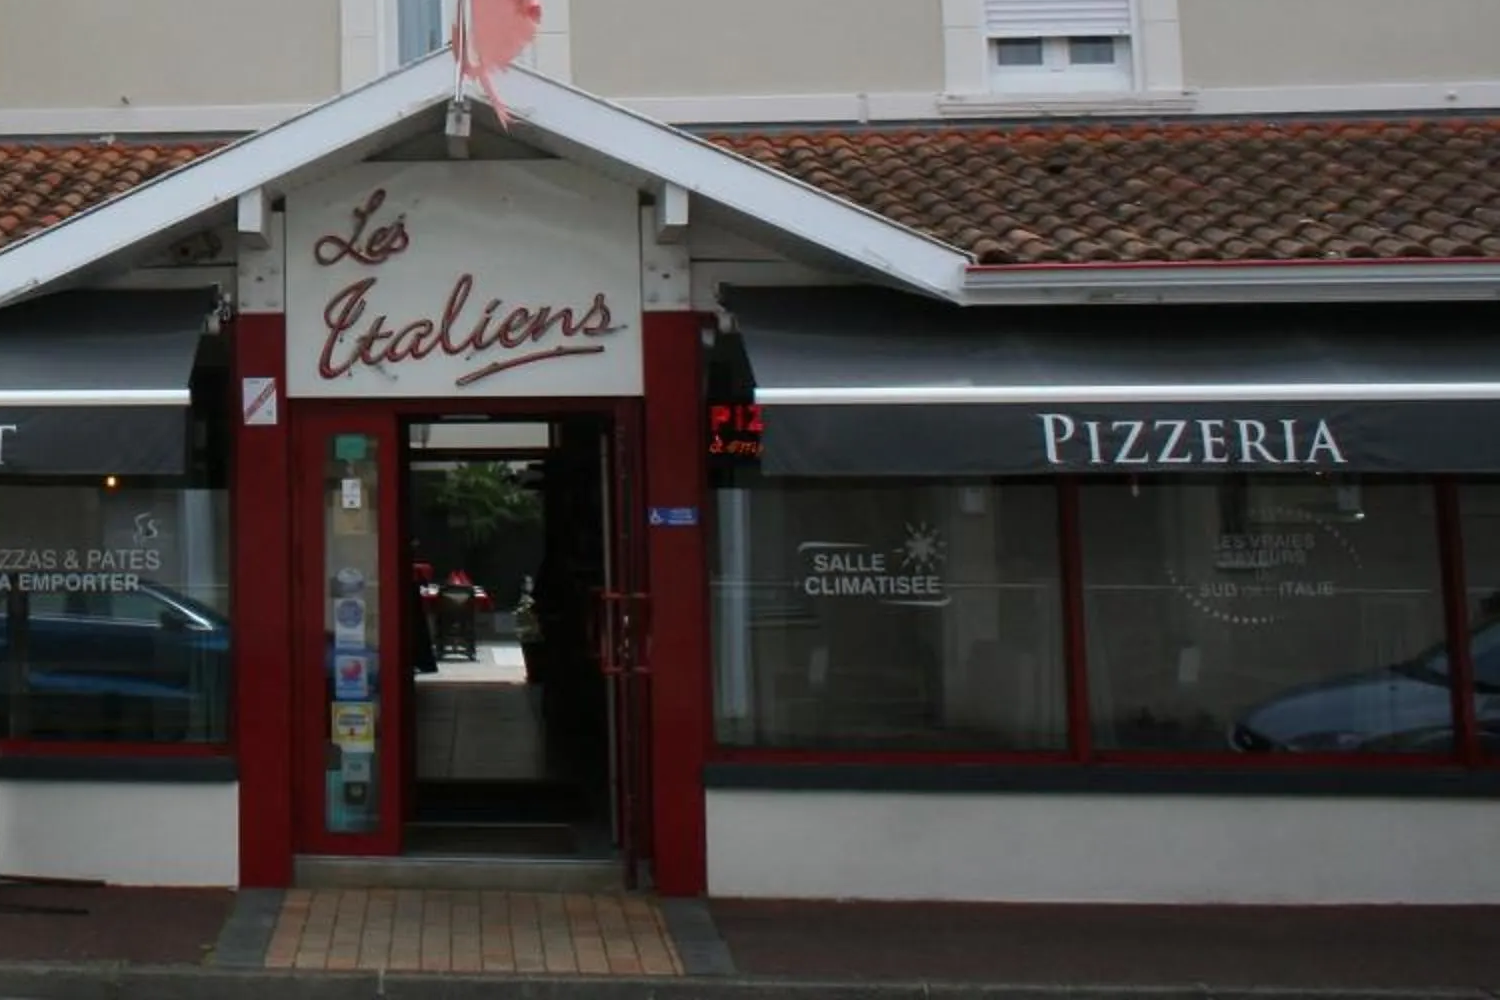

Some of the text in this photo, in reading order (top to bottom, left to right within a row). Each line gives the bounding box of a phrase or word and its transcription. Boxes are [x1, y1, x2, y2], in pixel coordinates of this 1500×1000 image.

[314, 188, 410, 267] Les
[316, 272, 627, 381] Italiens
[1037, 412, 1349, 465] PIZZERIA
[62, 548, 79, 570] &
[86, 548, 161, 570] PATES
[813, 551, 887, 573] SALLE
[18, 572, 140, 592] EMPORTER
[804, 575, 942, 596] CLIMATISEE
